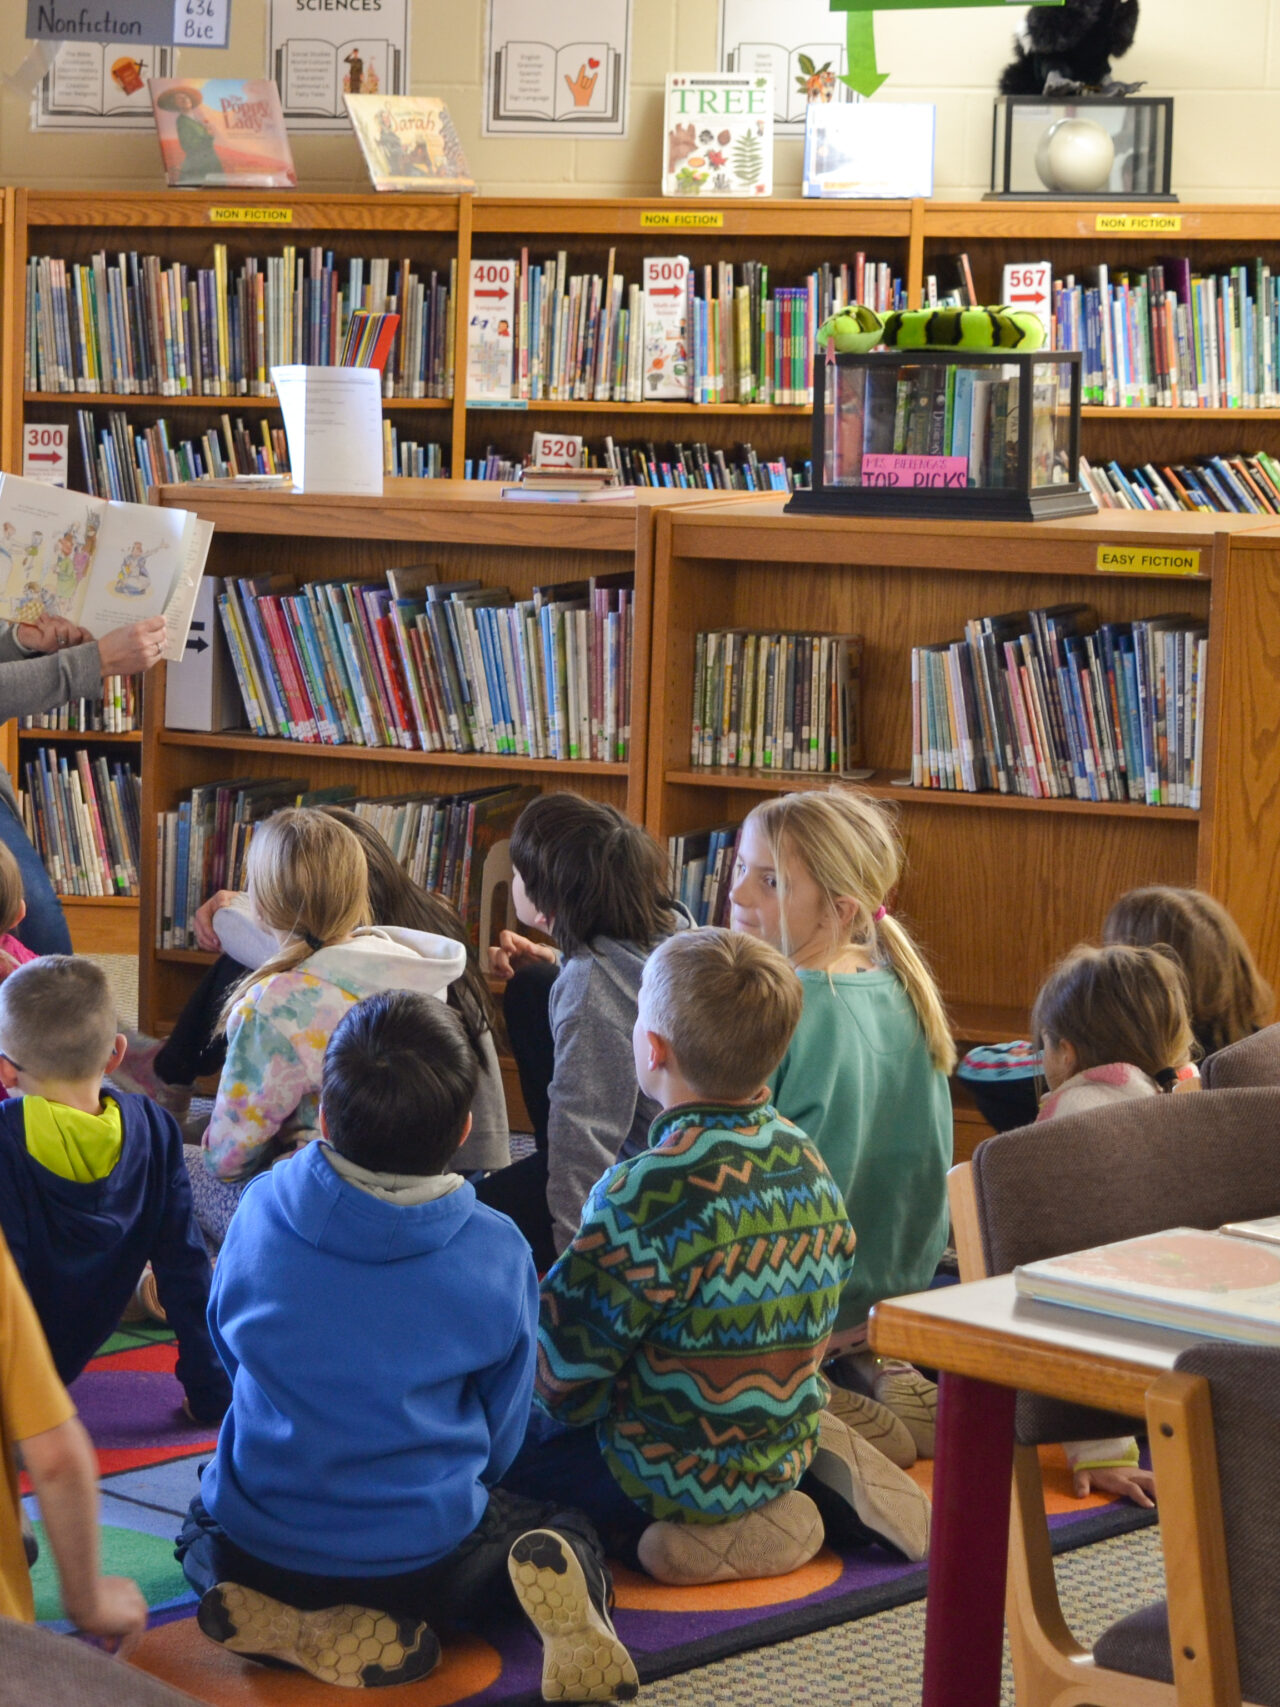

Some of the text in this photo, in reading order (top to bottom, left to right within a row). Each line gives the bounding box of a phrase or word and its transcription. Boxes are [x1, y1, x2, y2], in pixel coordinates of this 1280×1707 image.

[296, 0, 382, 11] SCIENCES
[37, 5, 142, 36] Nonfiction
[184, 19, 214, 39] Bie
[219, 97, 269, 118] Poppy
[671, 89, 767, 114] TREE
[223, 114, 264, 133] Lady
[215, 210, 288, 220] NON FICTION
[645, 214, 718, 225] NON FICTION
[1101, 219, 1175, 228] NON FICTION
[473, 266, 510, 283] 400
[649, 263, 684, 281] 500
[1009, 270, 1046, 287] 567
[28, 429, 63, 446] 300
[541, 440, 577, 458] 520
[863, 472, 966, 488] TOP PICKS
[1102, 553, 1193, 568] EASY FICTION
